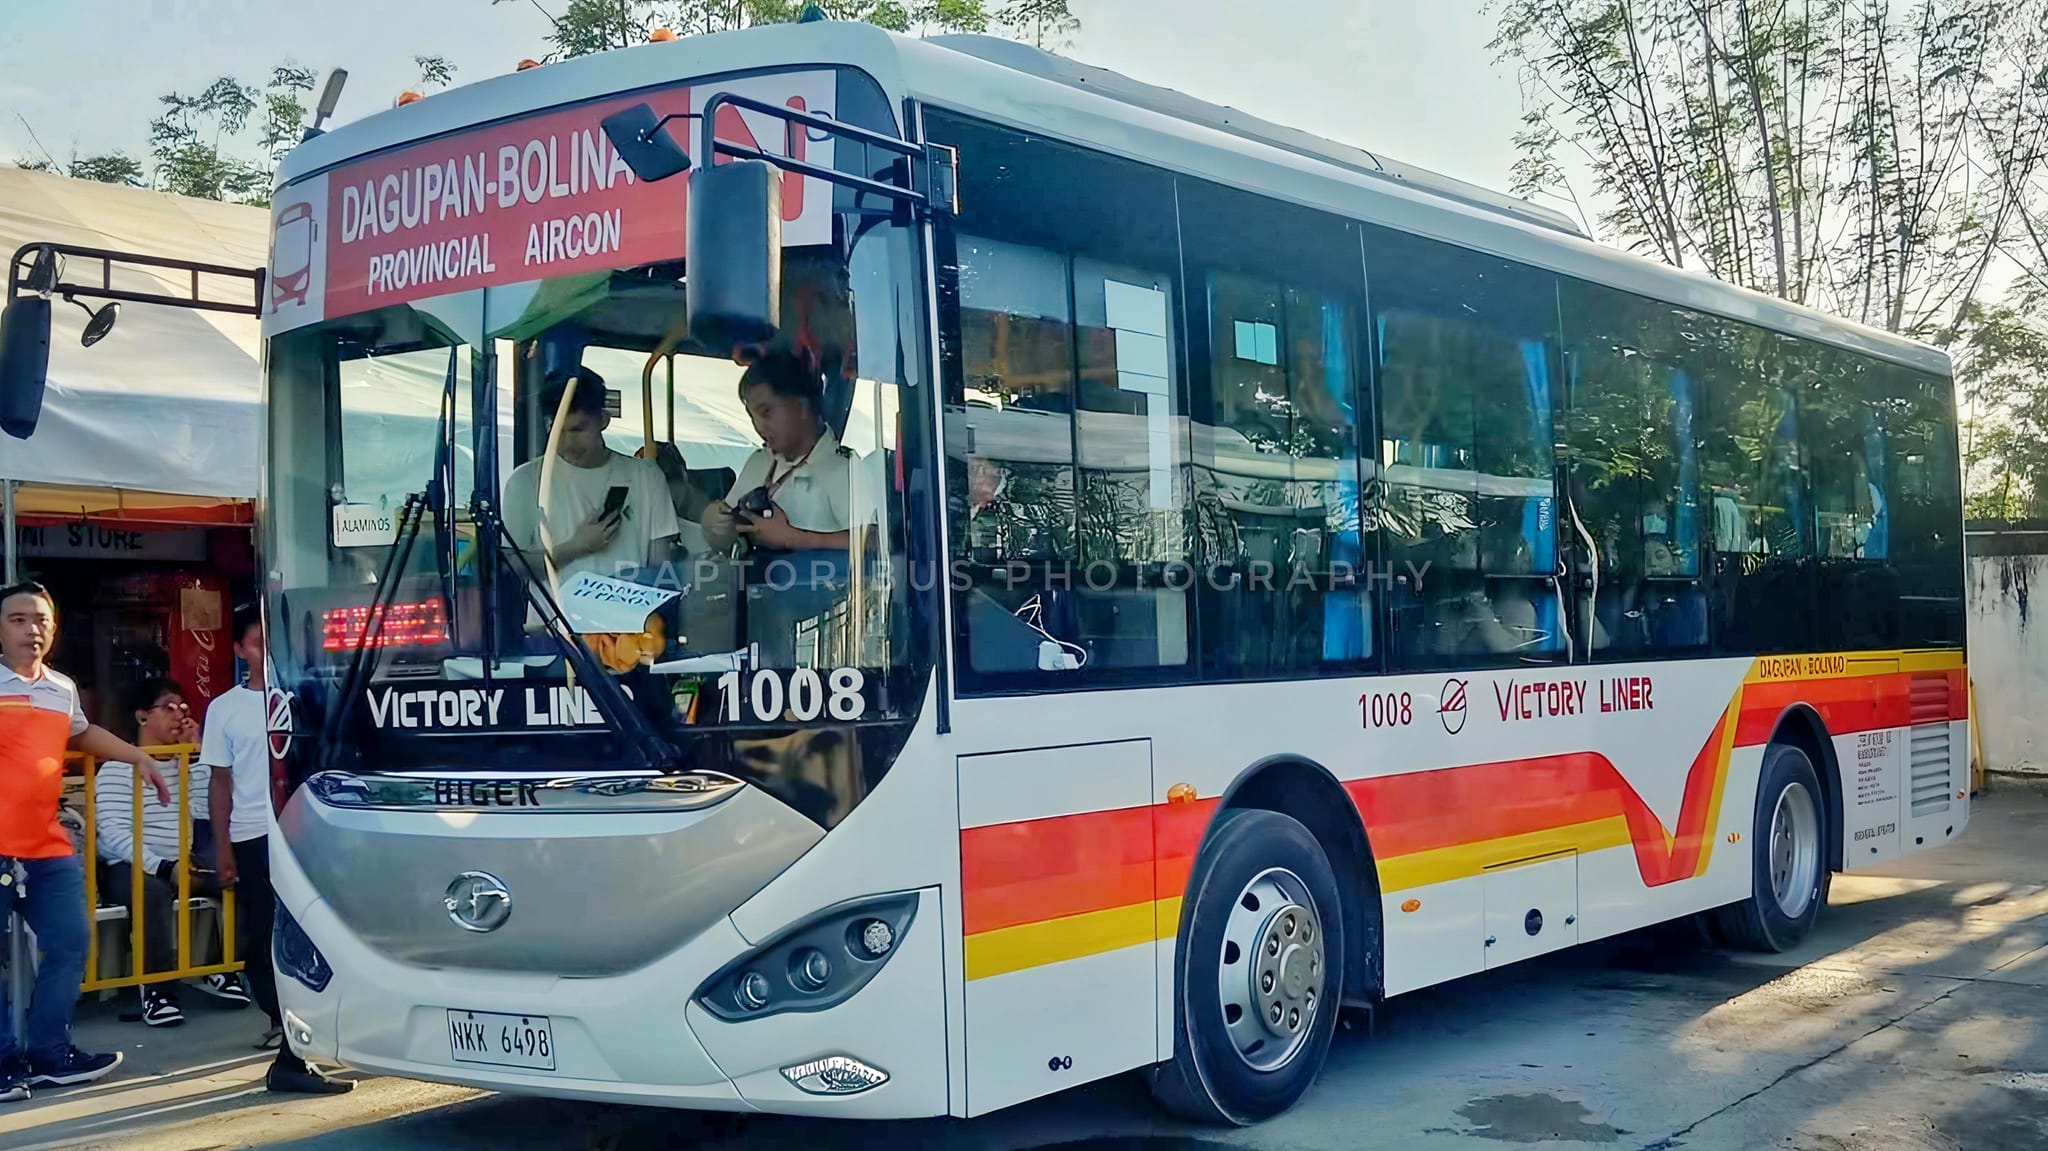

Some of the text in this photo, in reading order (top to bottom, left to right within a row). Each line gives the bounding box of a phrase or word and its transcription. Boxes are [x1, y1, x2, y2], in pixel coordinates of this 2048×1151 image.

[341, 126, 636, 244] DAGUPAN-BOLINA
[367, 208, 621, 295] PROVINCIAL AIRCON
[68, 522, 143, 550] STORE
[342, 518, 391, 533] ALAMINOS
[366, 684, 634, 728] VICTORY LINE
[718, 667, 866, 722] 1008
[1358, 691, 1412, 729] 1008
[1493, 676, 1654, 722] VICTORY LINER
[435, 778, 540, 806] HIGER
[451, 1020, 549, 1057] NKK 6498
